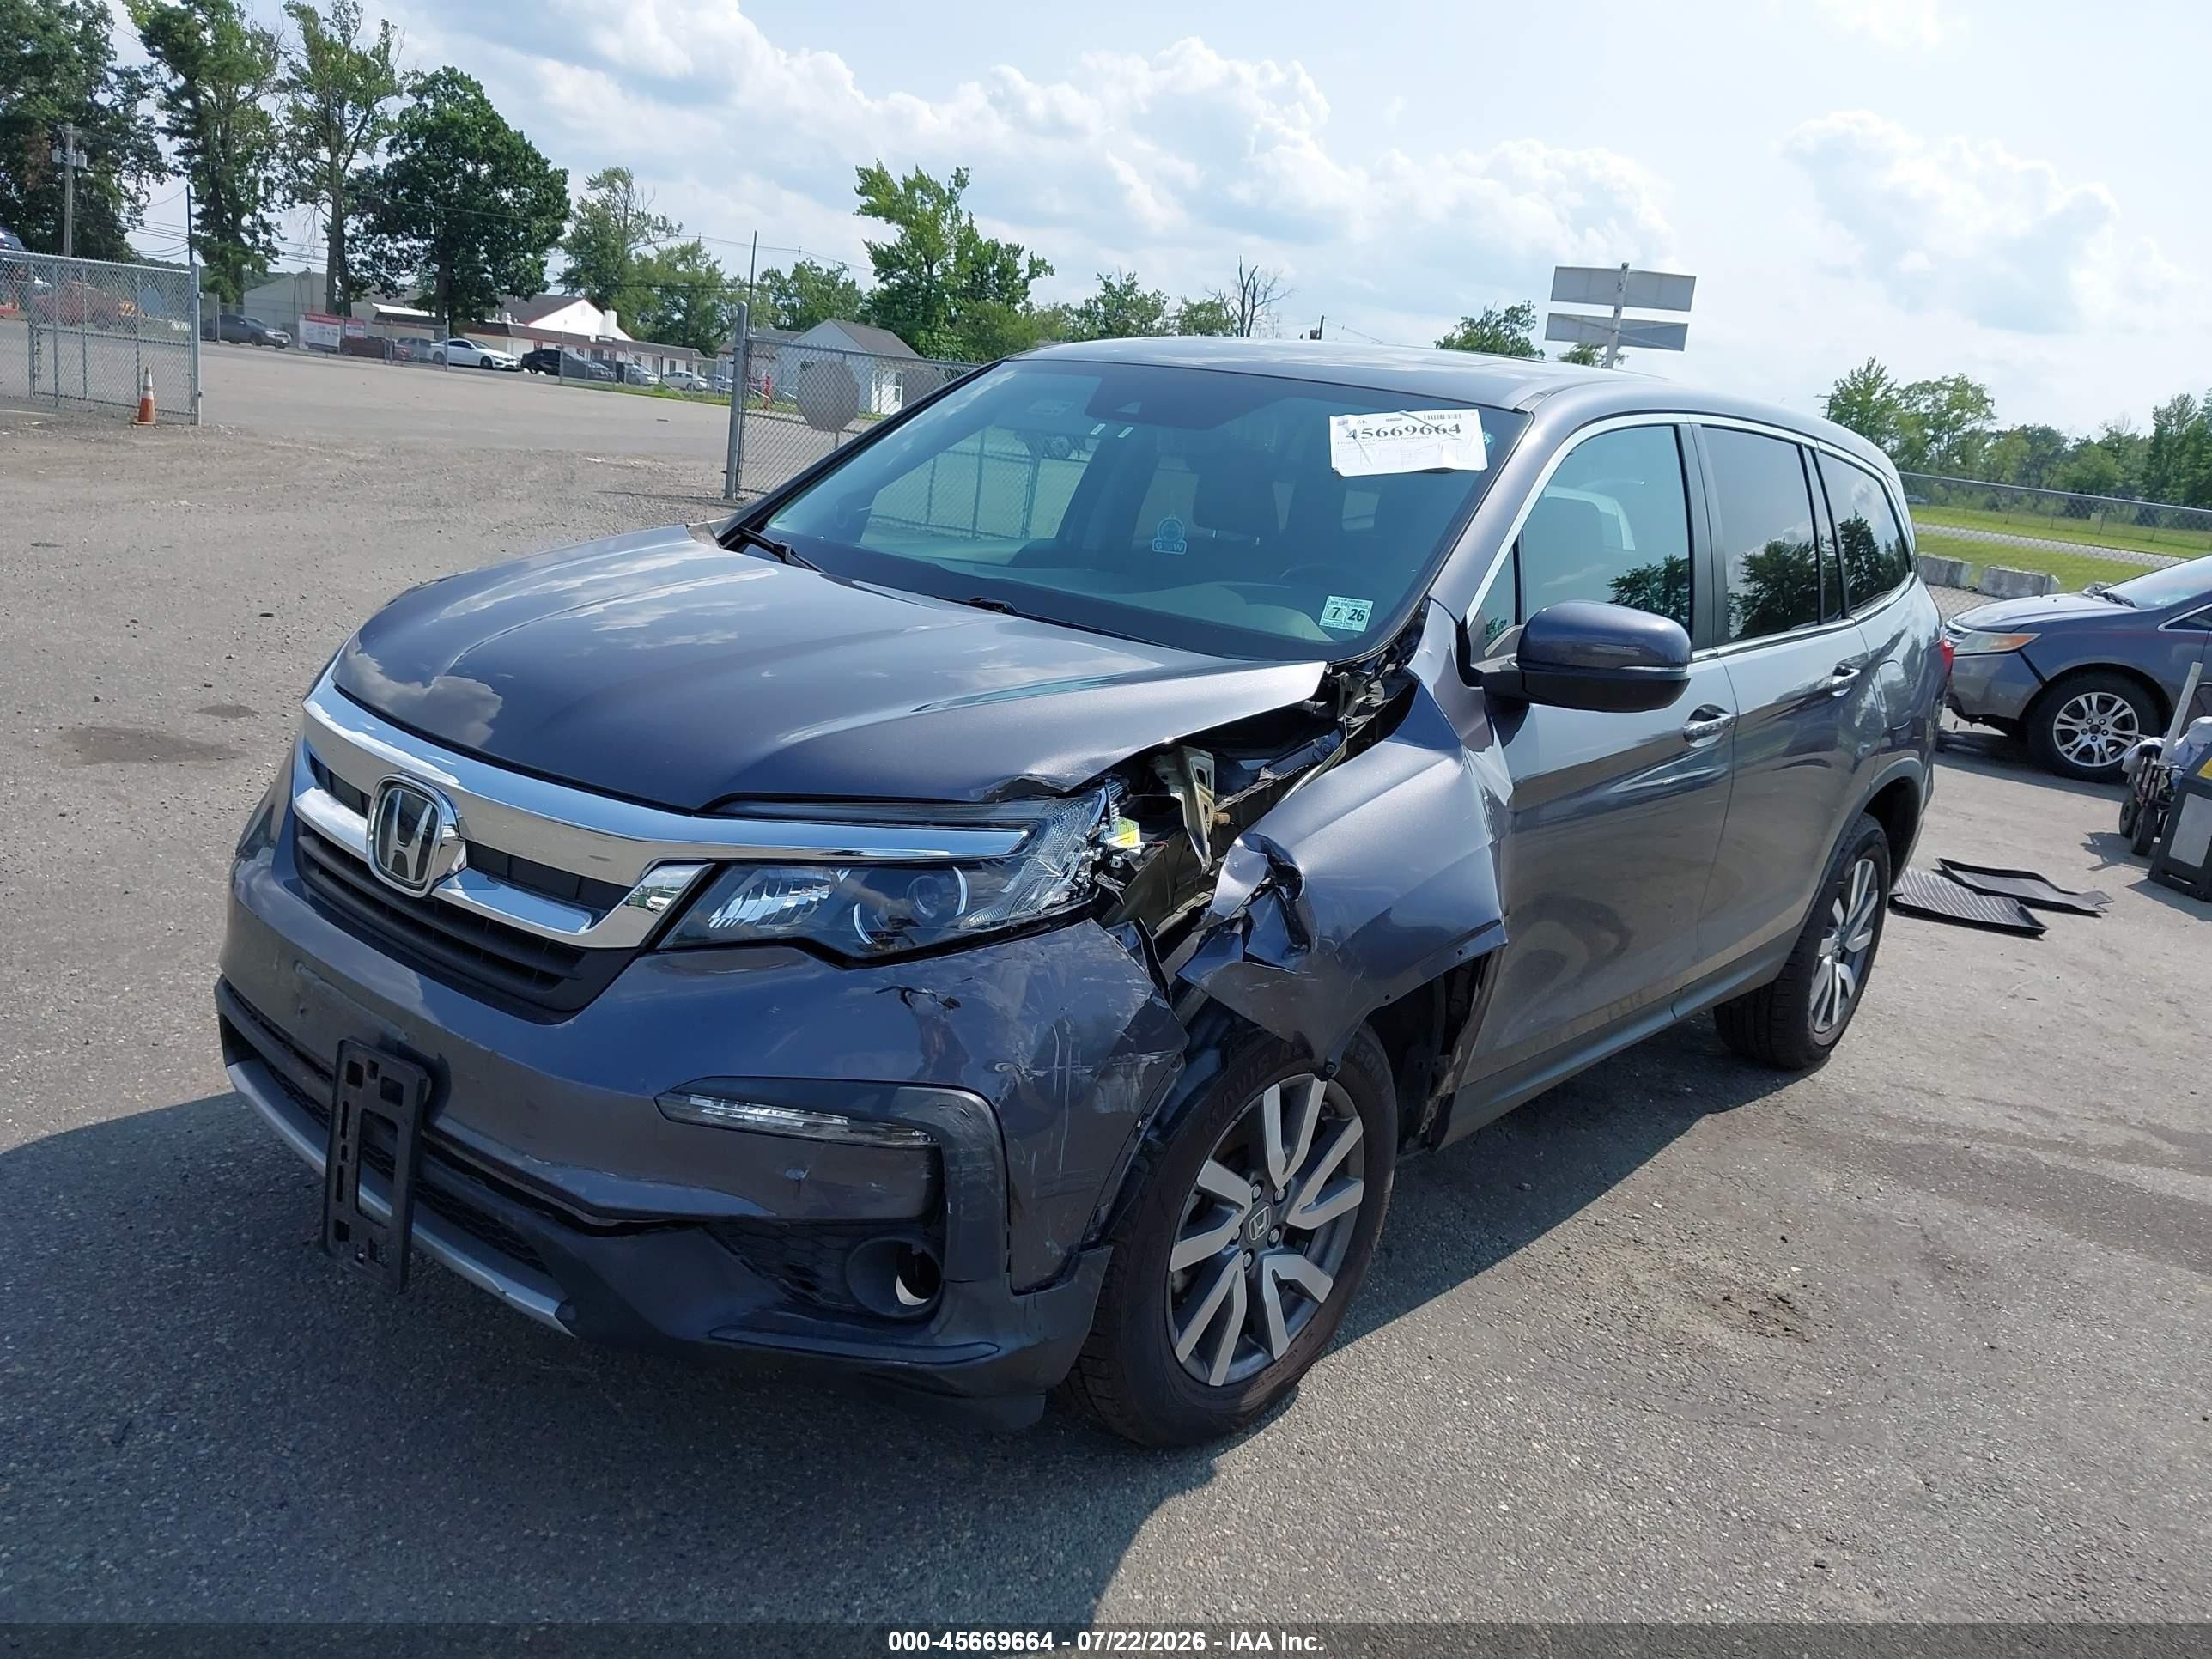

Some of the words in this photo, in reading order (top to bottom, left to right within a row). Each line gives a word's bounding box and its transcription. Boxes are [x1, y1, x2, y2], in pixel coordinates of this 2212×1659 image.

[1346, 423, 1462, 440] 45669664
[1331, 606, 1341, 619] 7
[1347, 608, 1366, 622] 26
